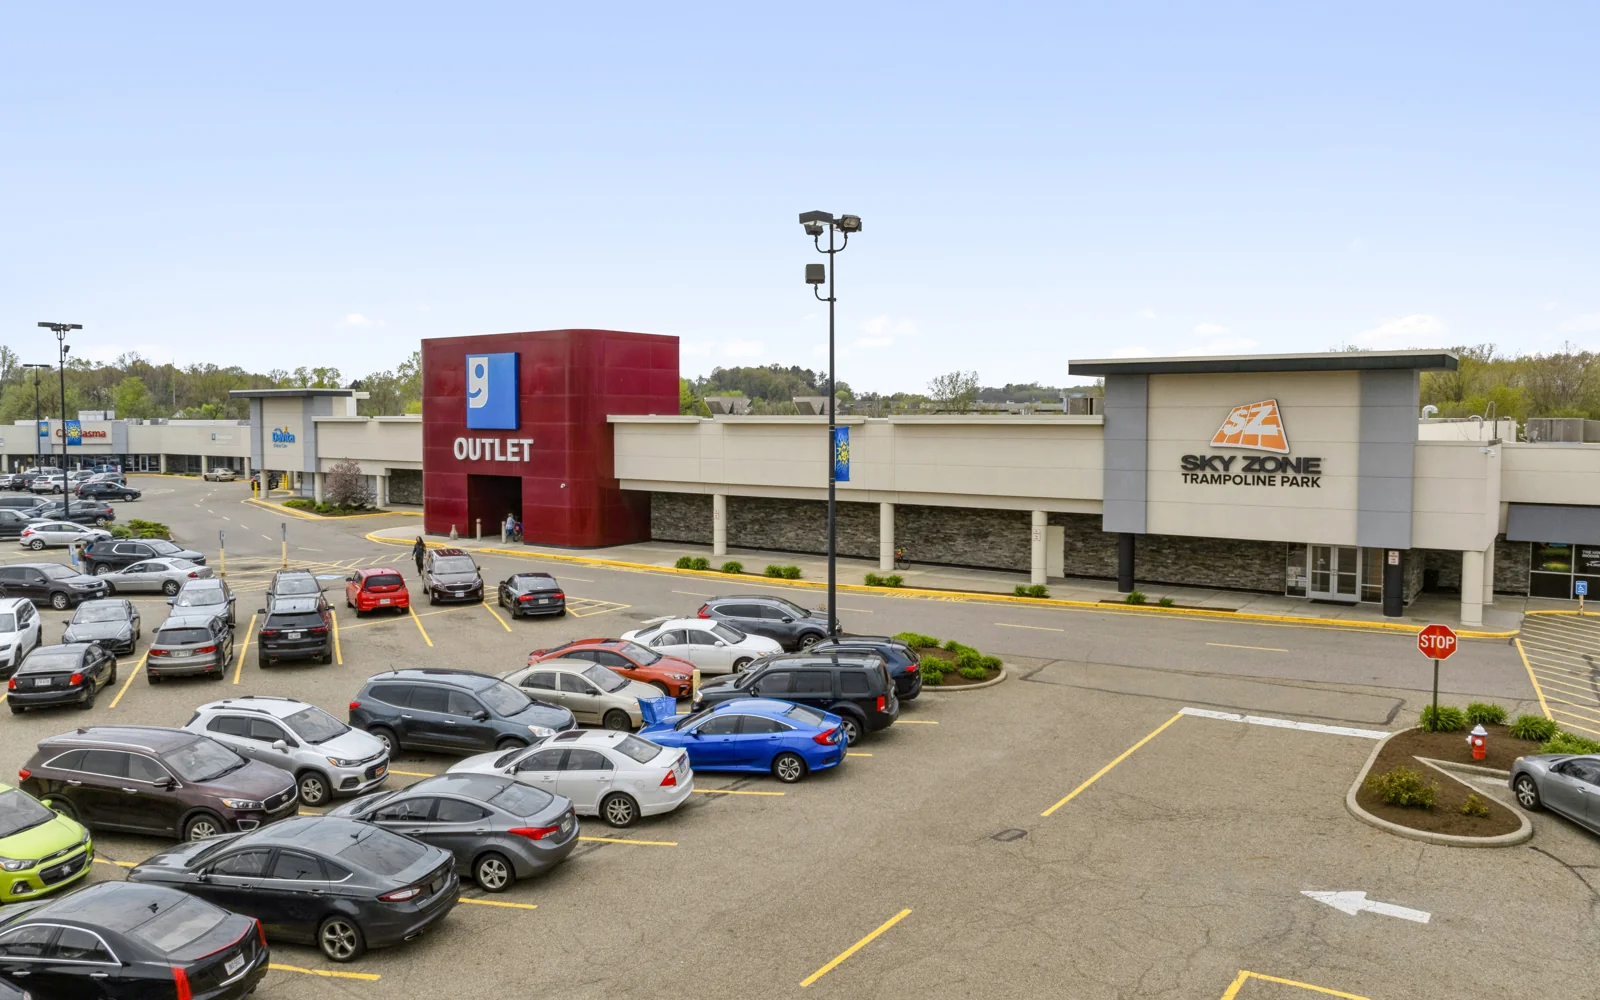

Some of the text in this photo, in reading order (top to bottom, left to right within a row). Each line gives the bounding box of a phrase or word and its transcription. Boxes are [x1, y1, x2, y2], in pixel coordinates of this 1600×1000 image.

[1223, 404, 1279, 436] SZ
[272, 430, 295, 443] DaVita
[453, 437, 534, 462] OUTLET
[1180, 454, 1322, 475] SKY ZONE
[1181, 473, 1321, 488] TRAMPOLINE PARK
[1420, 634, 1455, 649] STOP
